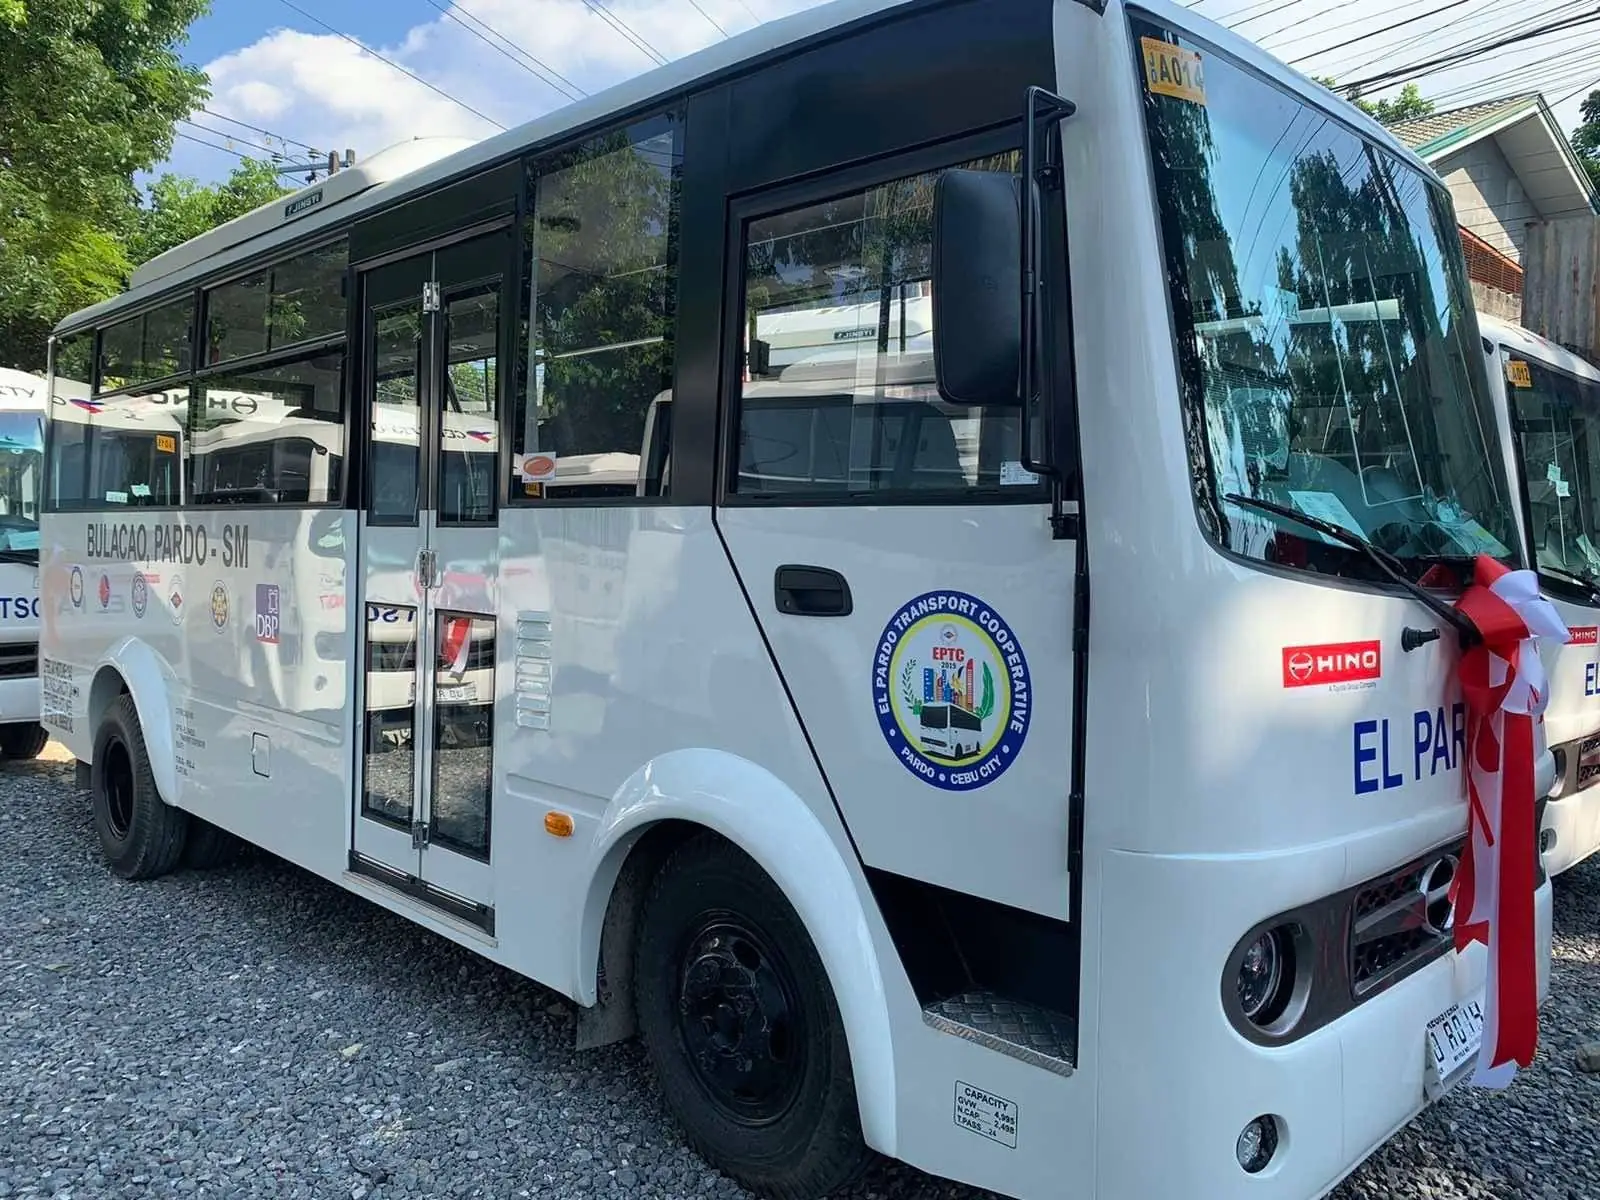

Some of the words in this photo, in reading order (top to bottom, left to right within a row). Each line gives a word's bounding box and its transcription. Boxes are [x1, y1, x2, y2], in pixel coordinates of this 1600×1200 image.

[154, 524, 208, 566] PARDO
[222, 524, 249, 568] SM
[894, 595, 978, 631] TRANSPORT
[257, 614, 279, 639] DBP
[1575, 630, 1597, 641] HINO
[876, 631, 897, 688] PARDO
[932, 646, 965, 662] EPTC
[1316, 651, 1377, 673] HINO
[978, 610, 1027, 734] COOPERATIVE
[879, 692, 890, 715] EL
[901, 746, 935, 779] PARDO
[950, 770, 980, 785] CEBU
[979, 755, 1002, 778] CITY
[1353, 719, 1403, 795] EL
[957, 1096, 977, 1109] GVW
[964, 1087, 1009, 1111] CAPACITY
